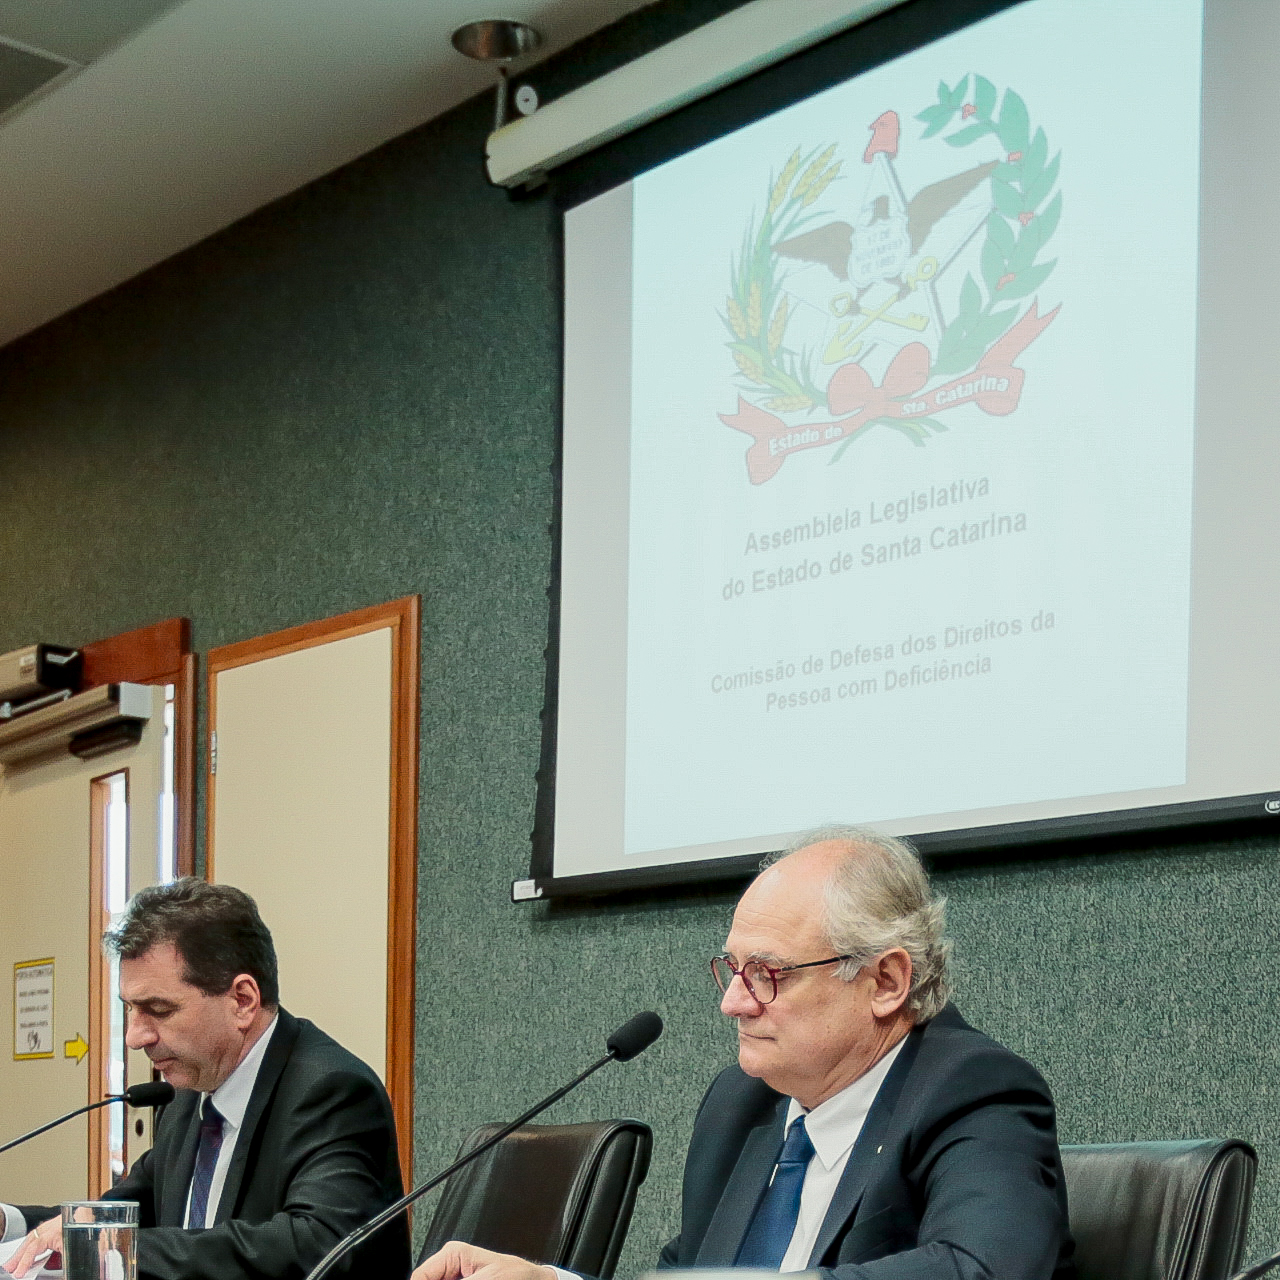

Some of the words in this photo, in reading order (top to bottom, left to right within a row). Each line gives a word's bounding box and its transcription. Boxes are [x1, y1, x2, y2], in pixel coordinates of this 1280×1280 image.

[768, 427, 820, 457] Estado
[824, 426, 843, 440] de
[935, 375, 1010, 406] Catarina
[721, 576, 745, 601] do
[752, 558, 822, 592] Estado
[828, 551, 854, 574] de
[860, 535, 922, 567] Santa
[929, 511, 1028, 550] Catarina
[743, 508, 862, 556] Assembleia
[870, 476, 990, 524] Legislativa
[710, 659, 796, 694] Comissão
[801, 654, 824, 676] de
[829, 639, 894, 671] Defesa
[901, 634, 937, 656] dos
[943, 609, 1023, 649] Direitos
[1030, 609, 1056, 632] da
[765, 686, 832, 712] Pessoa
[837, 677, 878, 699] com
[884, 653, 992, 692] Deficiência
